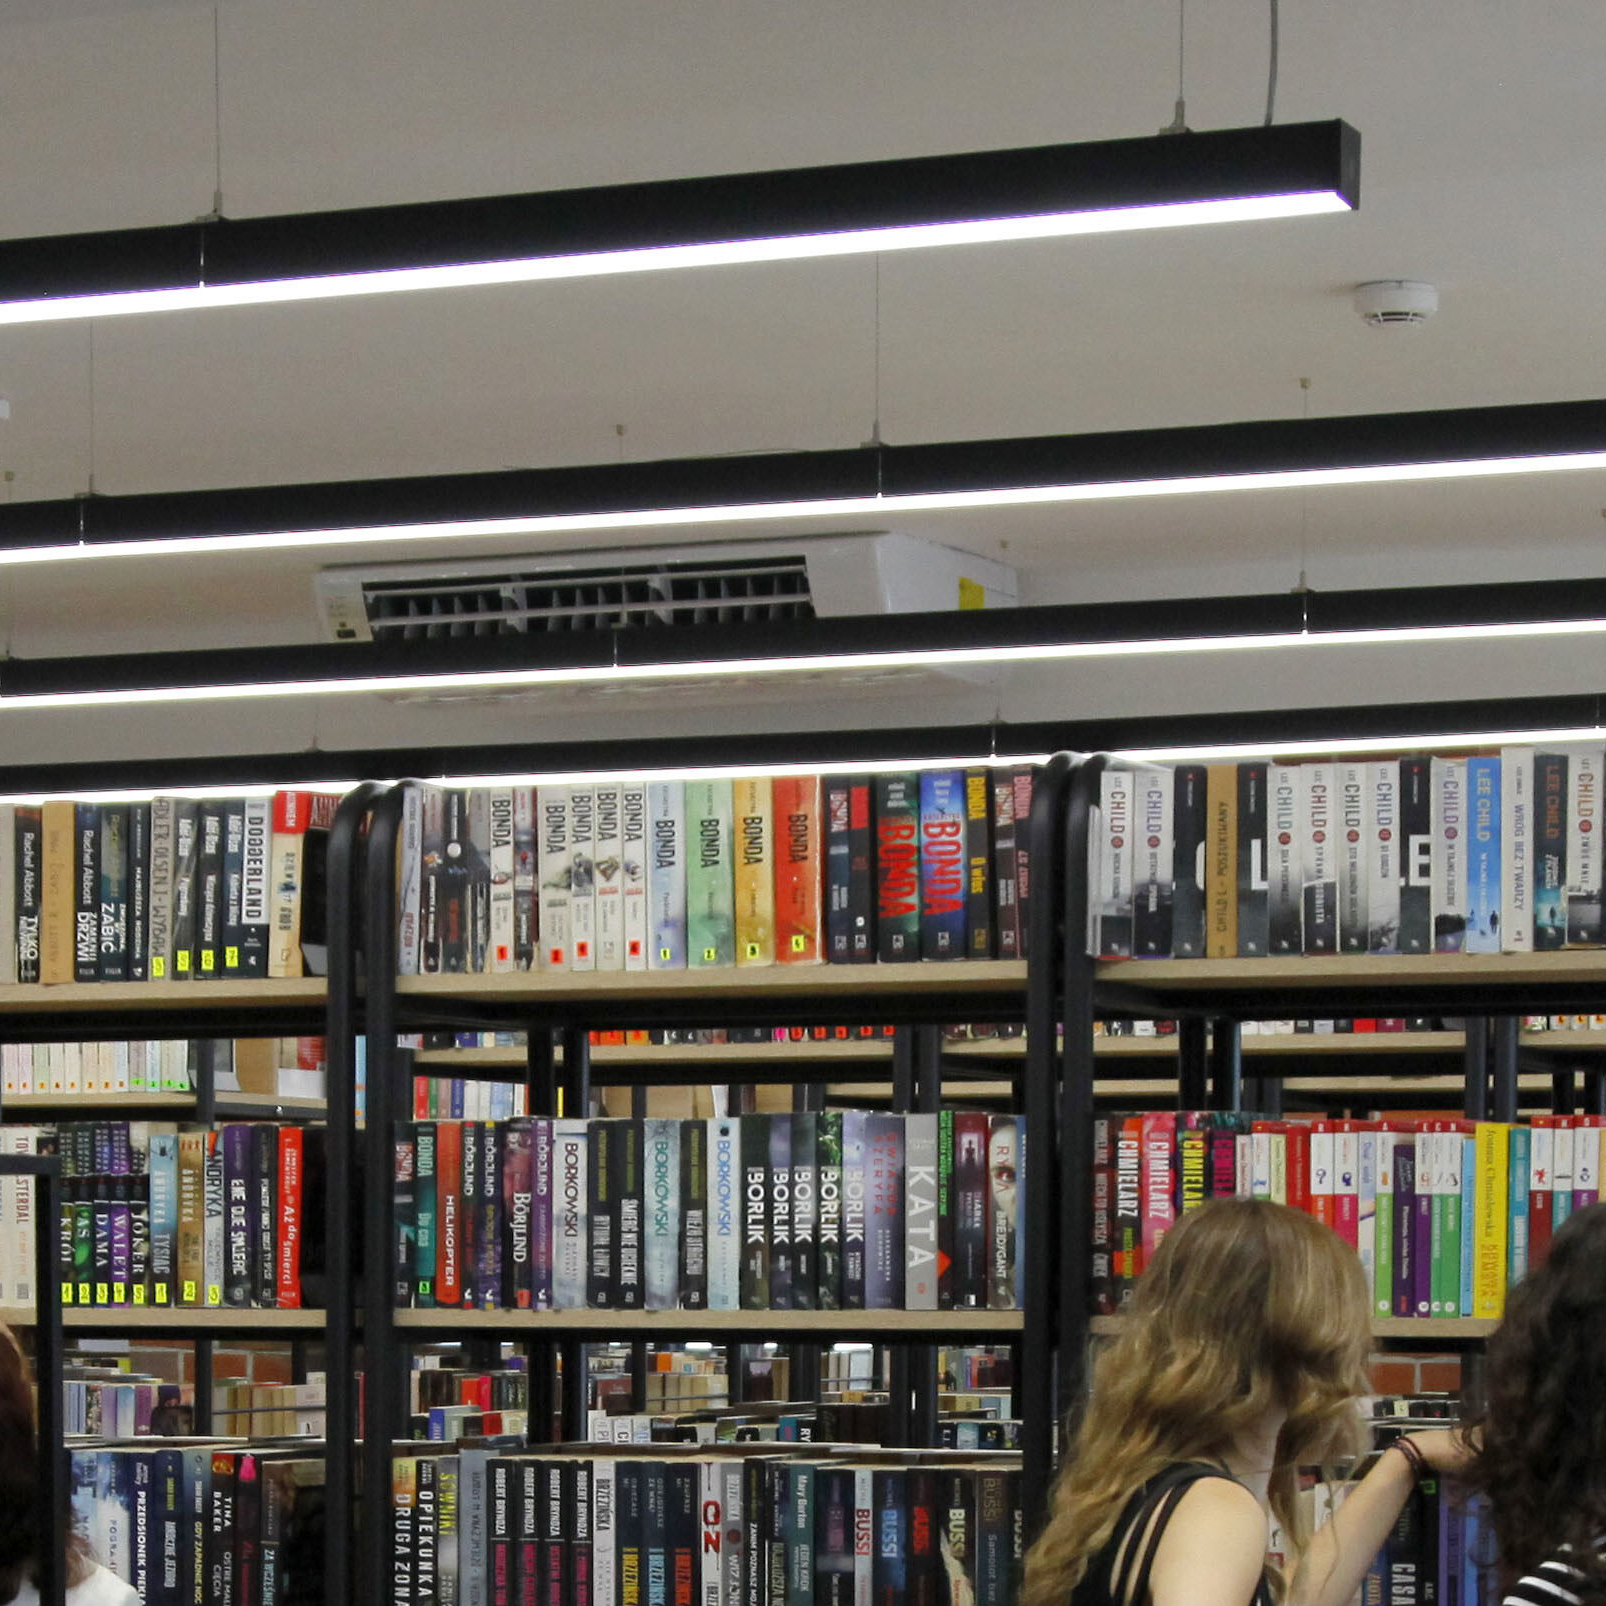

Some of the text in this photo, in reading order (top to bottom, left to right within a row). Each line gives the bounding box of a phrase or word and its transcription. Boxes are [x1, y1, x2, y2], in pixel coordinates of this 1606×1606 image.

[573, 795, 591, 843] BONDA
[598, 793, 616, 841] BONDA
[625, 793, 642, 841] BONDA
[967, 777, 986, 819] BONDA
[1110, 791, 1125, 833] CHILD
[1147, 790, 1161, 833] CHILD
[1277, 786, 1292, 829] CHILD
[1346, 784, 1360, 827] CHILD
[1377, 783, 1392, 825] CHILD
[1444, 781, 1458, 823] CHILD
[1579, 774, 1593, 817] CHILD
[492, 800, 511, 847] BONDA
[546, 806, 566, 853] BONDA
[656, 821, 674, 868] BONDA
[701, 819, 719, 868] BONDA
[744, 816, 762, 865] BONDA
[788, 814, 807, 862] BONDA
[23, 833, 34, 907] Rachel Abbott
[82, 830, 93, 904] Rachel Abbott
[878, 824, 917, 918] BONDA
[923, 821, 963, 915] BONDA
[1514, 804, 1525, 910] WRÓG BEZ TWARZY
[101, 903, 119, 953] ZABIĆ
[417, 1136, 432, 1176] BONDA
[1118, 1141, 1137, 1216] CHMIELARZ
[1149, 1142, 1169, 1218] CHMIELARZ
[206, 1150, 222, 1218] ANDRYKA
[564, 1143, 578, 1236] BORKOWSKI
[655, 1141, 668, 1236] BORKOWSKI
[718, 1141, 731, 1236] BORKOWSKI
[747, 1172, 764, 1243] BORLIK
[774, 1173, 789, 1244] BORLIK
[795, 1172, 812, 1243] BORLIK
[821, 1172, 837, 1243] BORLIK
[846, 1170, 864, 1242] BORLIK
[1484, 1129, 1497, 1237] Joanna Chmielewska
[77, 1217, 90, 1238] AS
[96, 1213, 108, 1267] DAMA
[445, 1196, 454, 1286] HELIKOPTER
[908, 1166, 935, 1268] KATA
[115, 1214, 127, 1278] WALET
[132, 1213, 145, 1274] JOKER
[496, 1468, 505, 1497] ROBERT
[524, 1467, 534, 1534] ROBERT BRYNDZA
[550, 1469, 560, 1536] ROBERT BRYNDZA
[577, 1471, 587, 1537] ROBERT BRYNDZA
[137, 1491, 146, 1566] PRZEDSIONEK
[213, 1491, 221, 1532] BAKER
[224, 1497, 232, 1527] TINA
[394, 1493, 410, 1554] DRUGA
[496, 1500, 505, 1534] BRYNDZA
[855, 1508, 871, 1555] BUSSI
[881, 1509, 898, 1558] BUSSI
[949, 1509, 965, 1557] BUSSI
[223, 1552, 231, 1581] OSTRE
[418, 1491, 433, 1596] OPIEKUNKA
